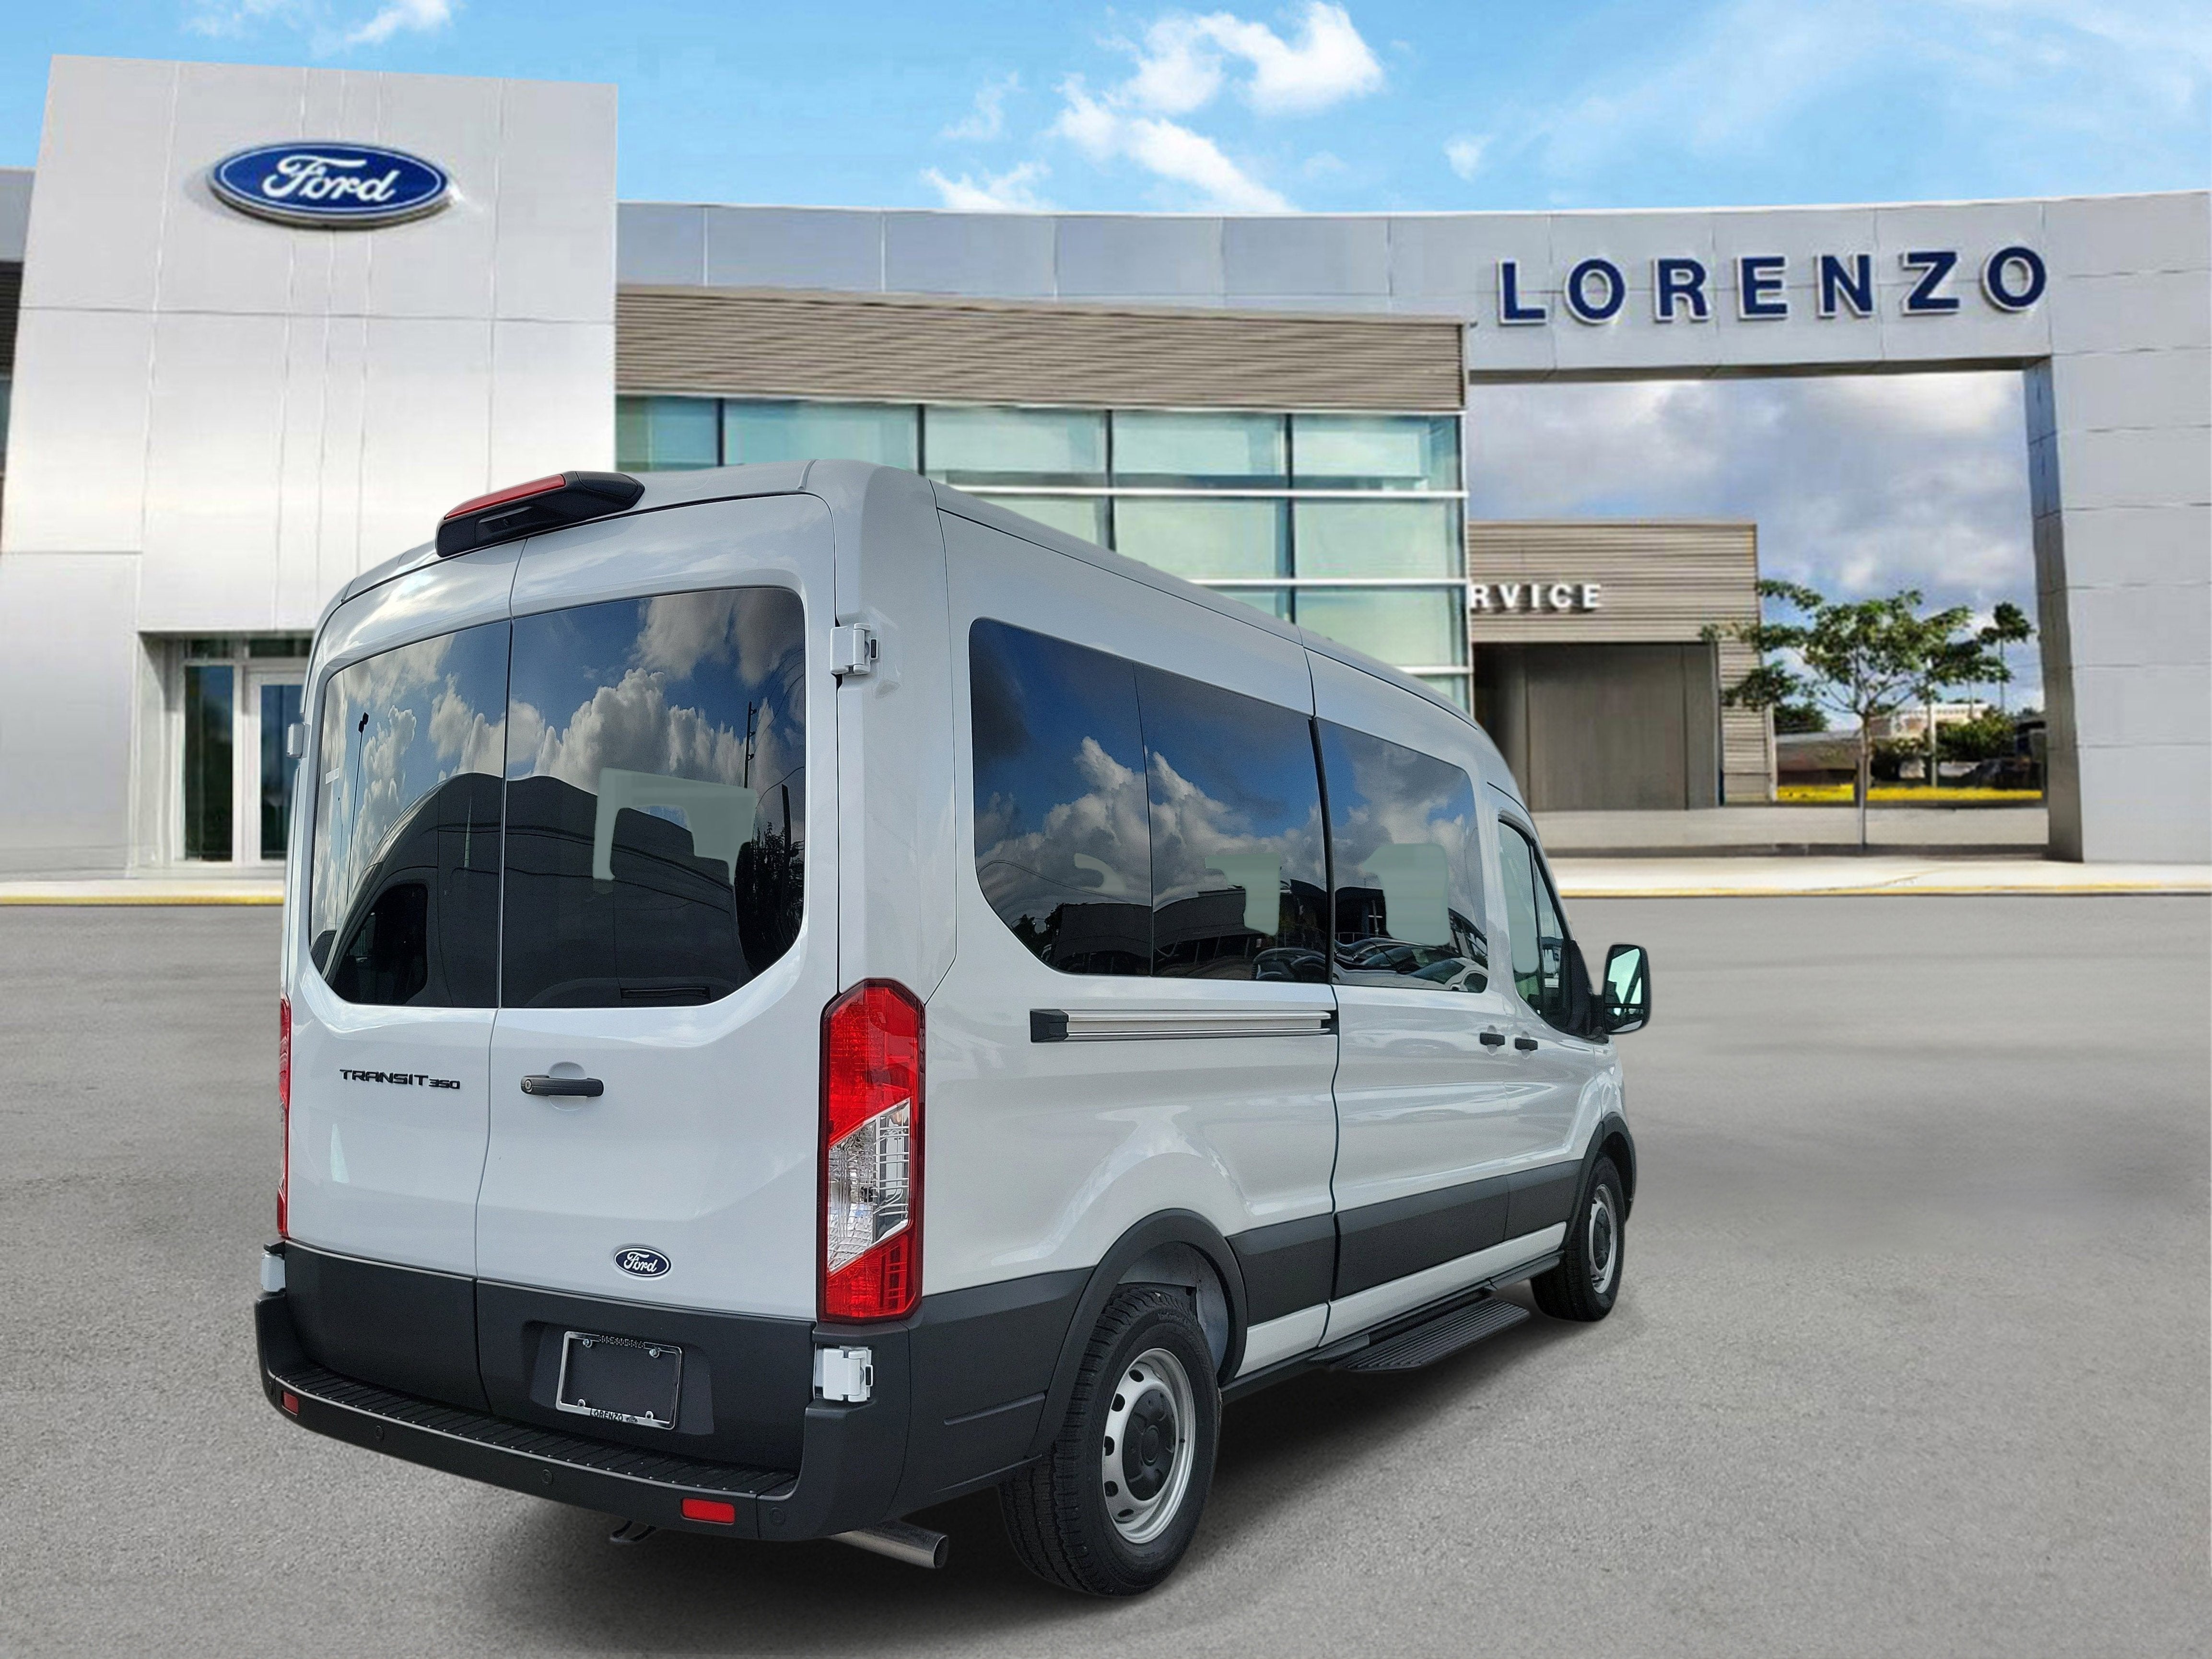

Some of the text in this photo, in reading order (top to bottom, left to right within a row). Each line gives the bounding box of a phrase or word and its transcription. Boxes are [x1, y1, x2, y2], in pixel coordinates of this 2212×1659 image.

[262, 155, 401, 202] Ford
[1498, 246, 2047, 326] LORENZO
[339, 1069, 460, 1089] TRANSIT 350
[623, 1251, 658, 1272] Ford
[589, 1408, 623, 1422] LORENZO
